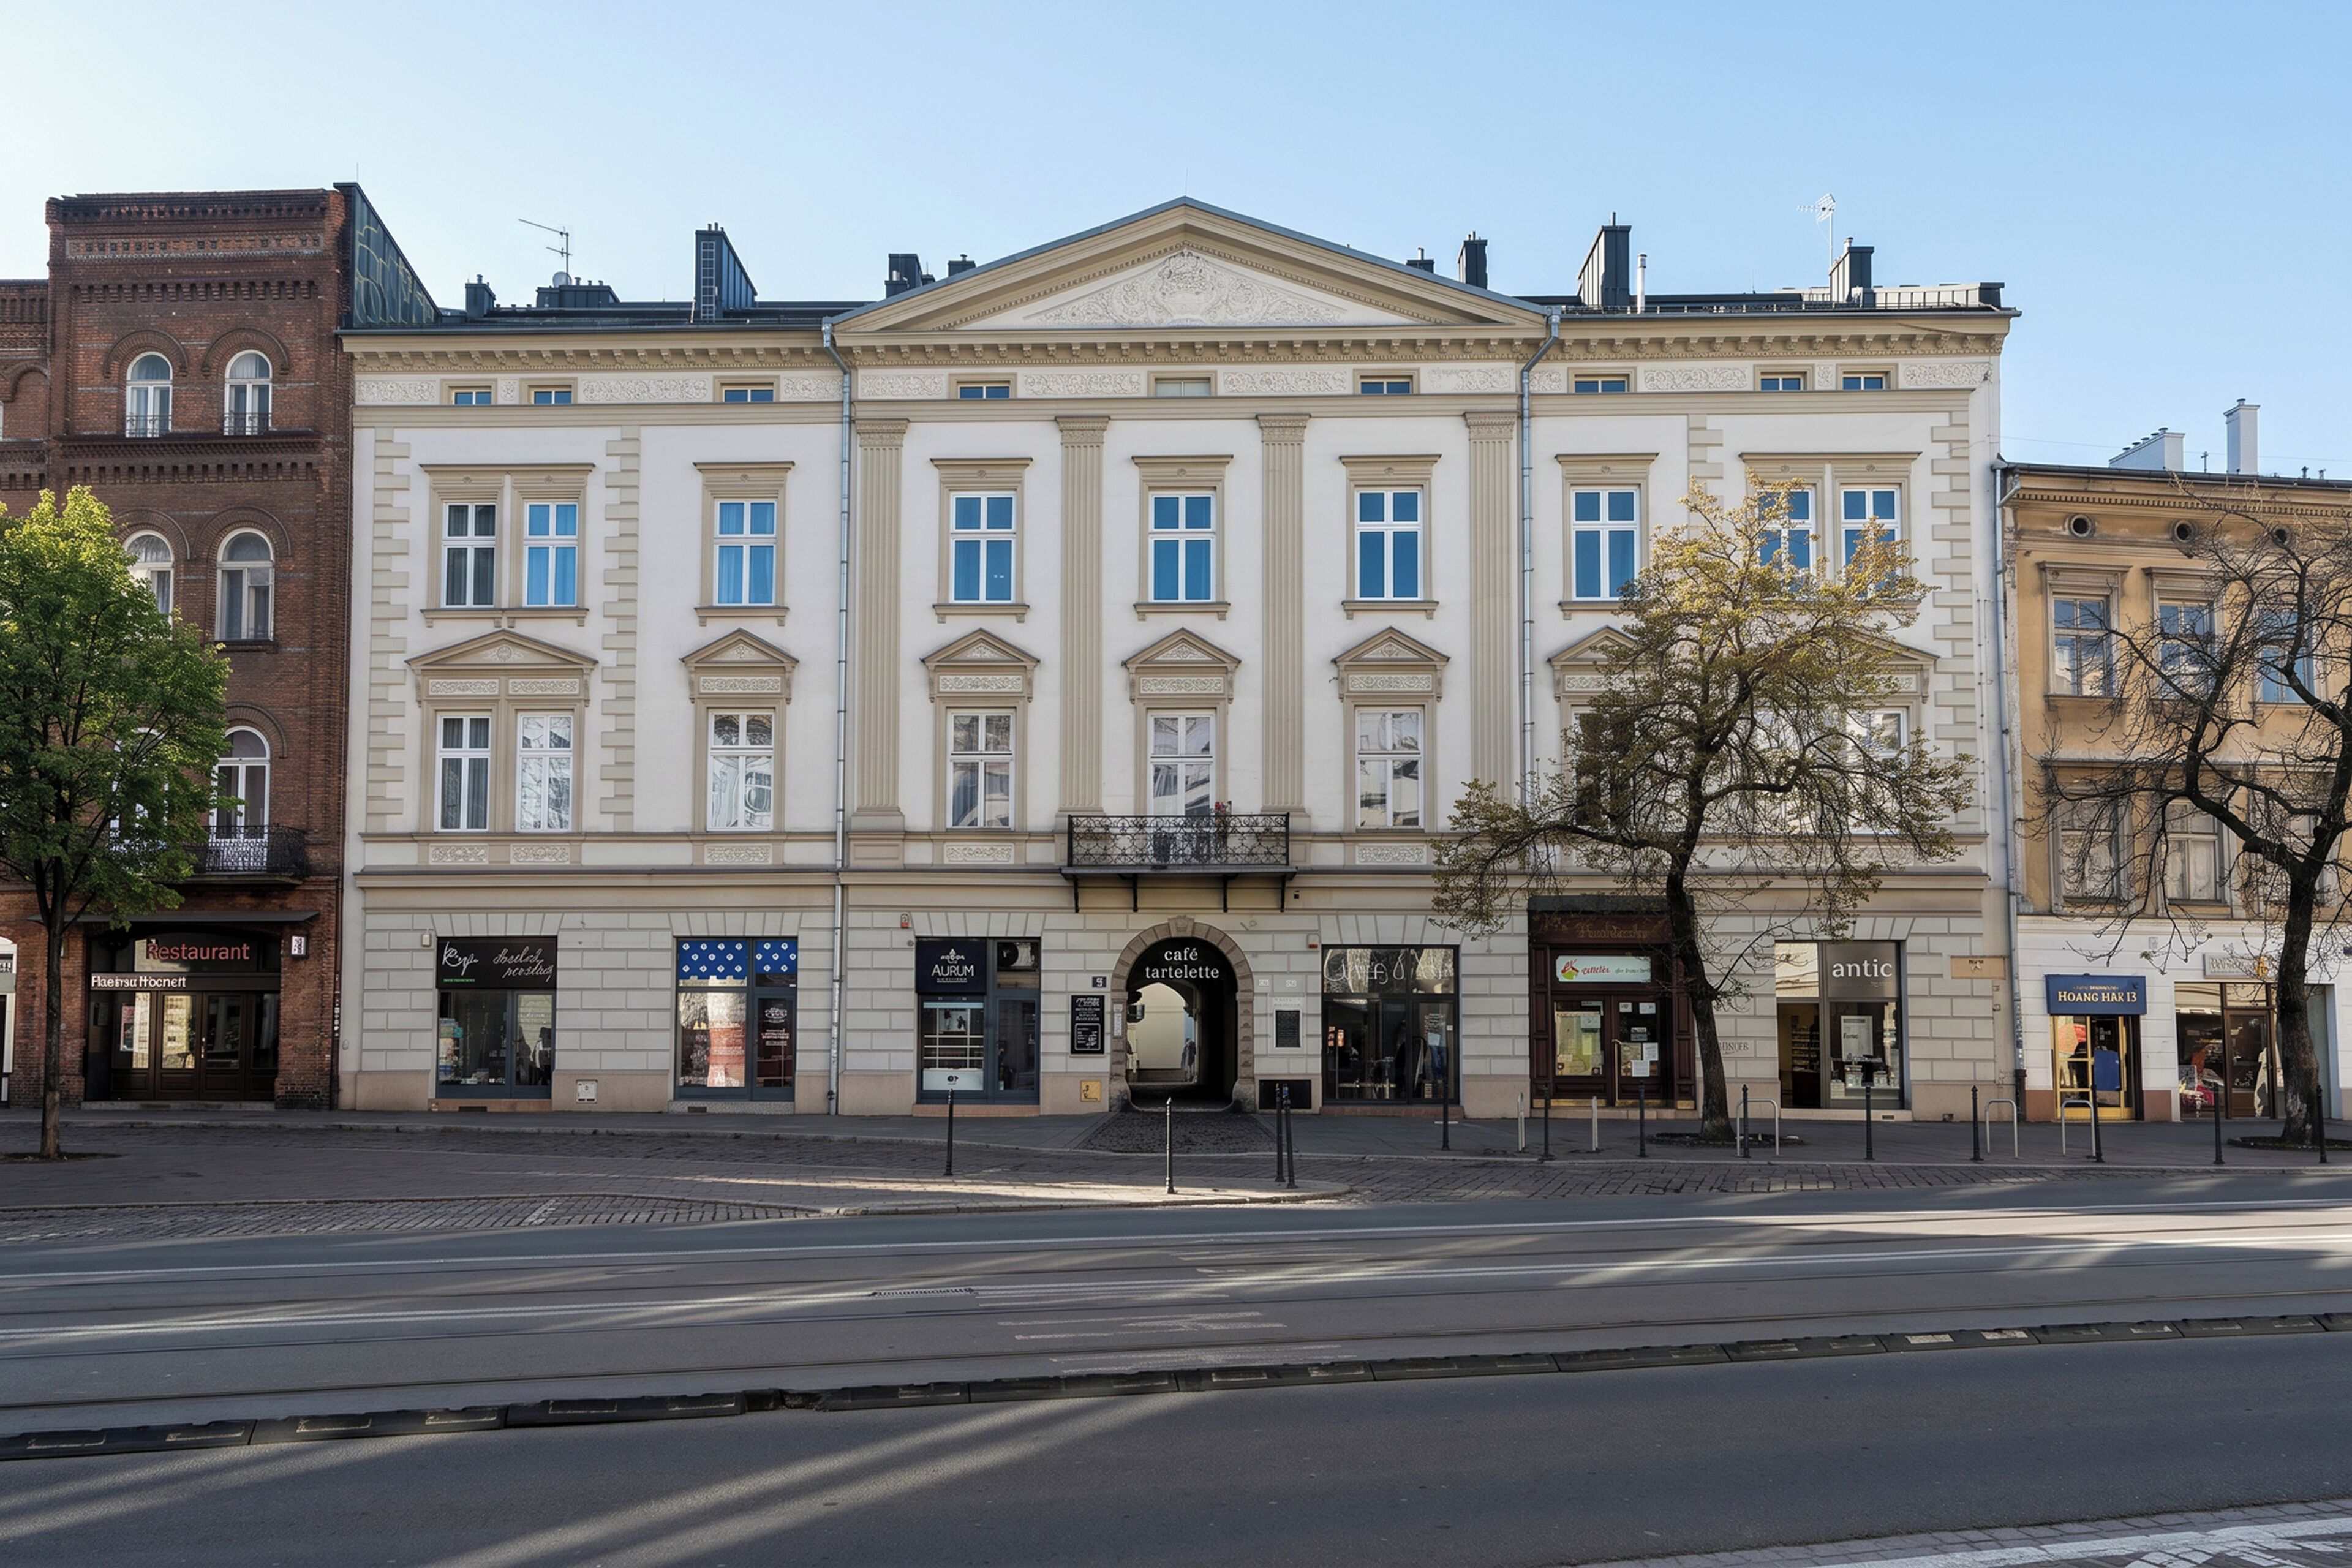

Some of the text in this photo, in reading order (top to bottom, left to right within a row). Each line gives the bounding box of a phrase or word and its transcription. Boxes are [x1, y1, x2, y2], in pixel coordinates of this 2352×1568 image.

[146, 943, 250, 960] Restaurant
[1164, 947, 1198, 961] café
[931, 964, 974, 976] AURUM
[1145, 965, 1219, 978] tartelette
[1832, 959, 1893, 977] antic
[2058, 991, 2098, 1002] HOANG
[2127, 992, 2137, 1003] 13
